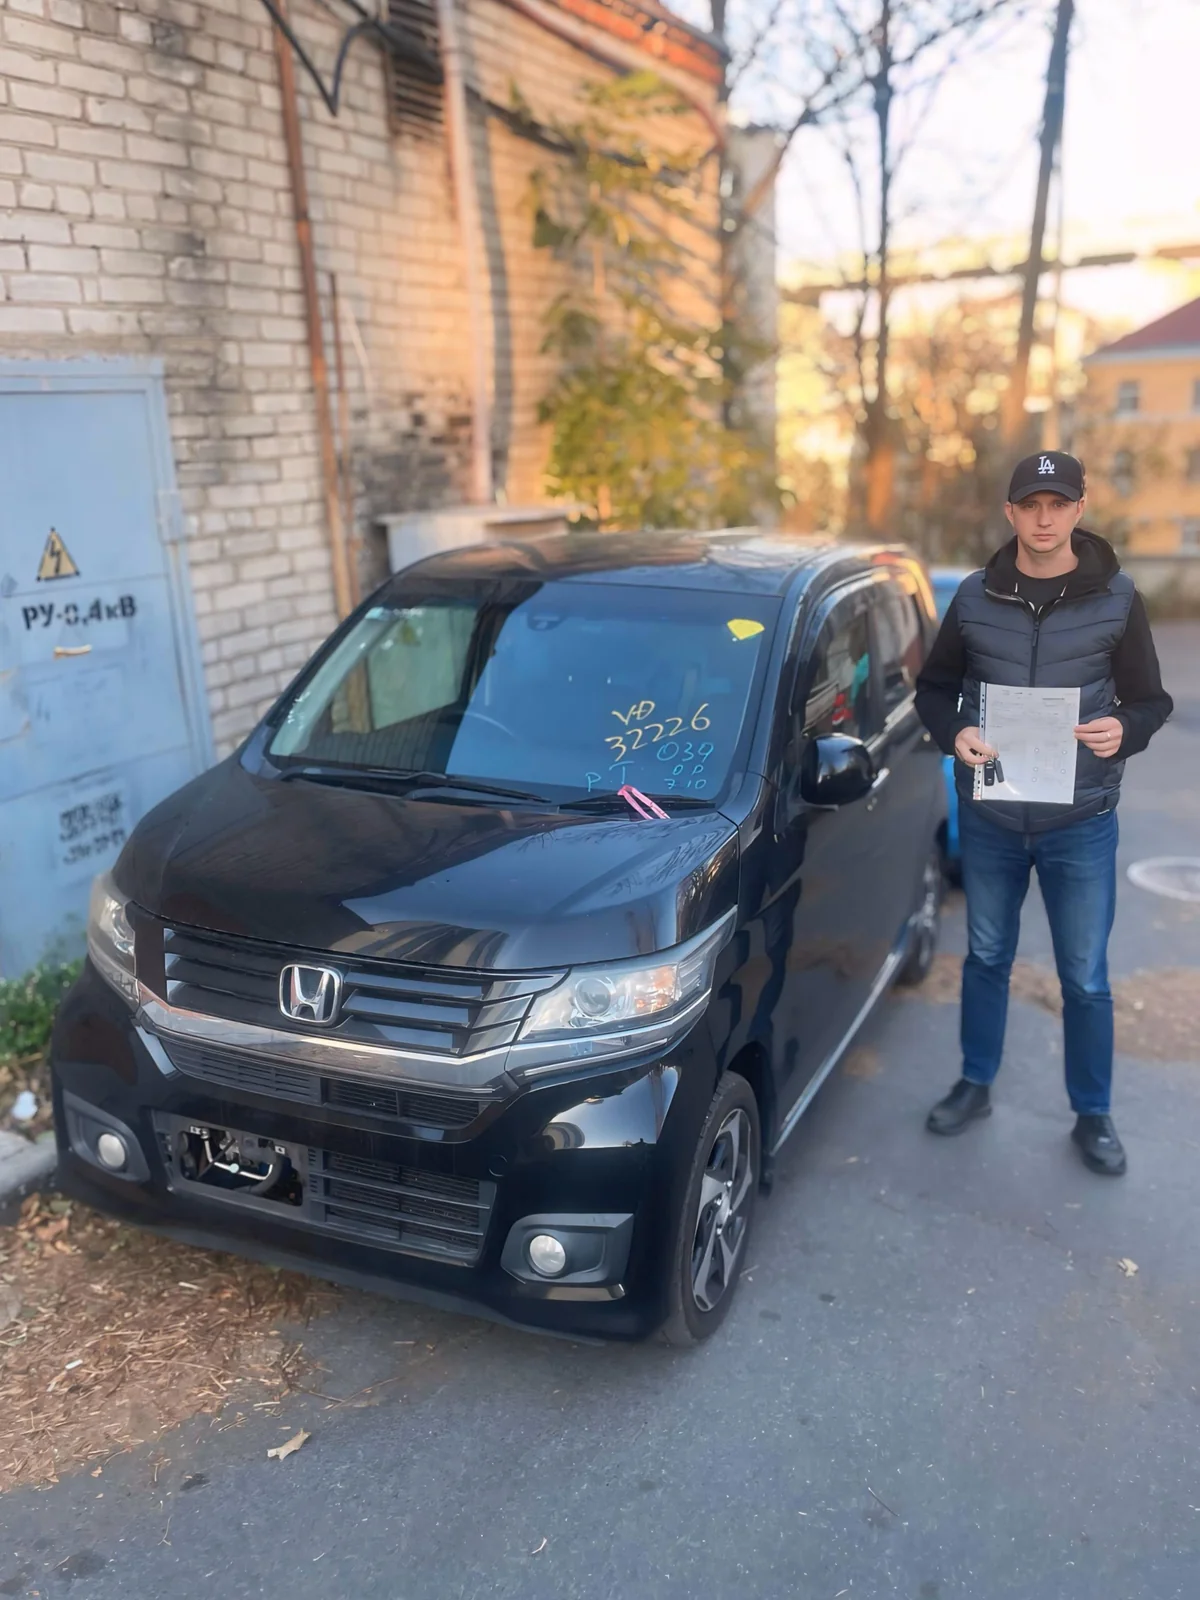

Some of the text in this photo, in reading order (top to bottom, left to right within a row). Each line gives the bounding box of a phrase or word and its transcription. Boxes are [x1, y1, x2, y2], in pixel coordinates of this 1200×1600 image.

[1038, 456, 1055, 474] LA
[604, 703, 711, 762] 32226
[656, 741, 714, 763] 039
